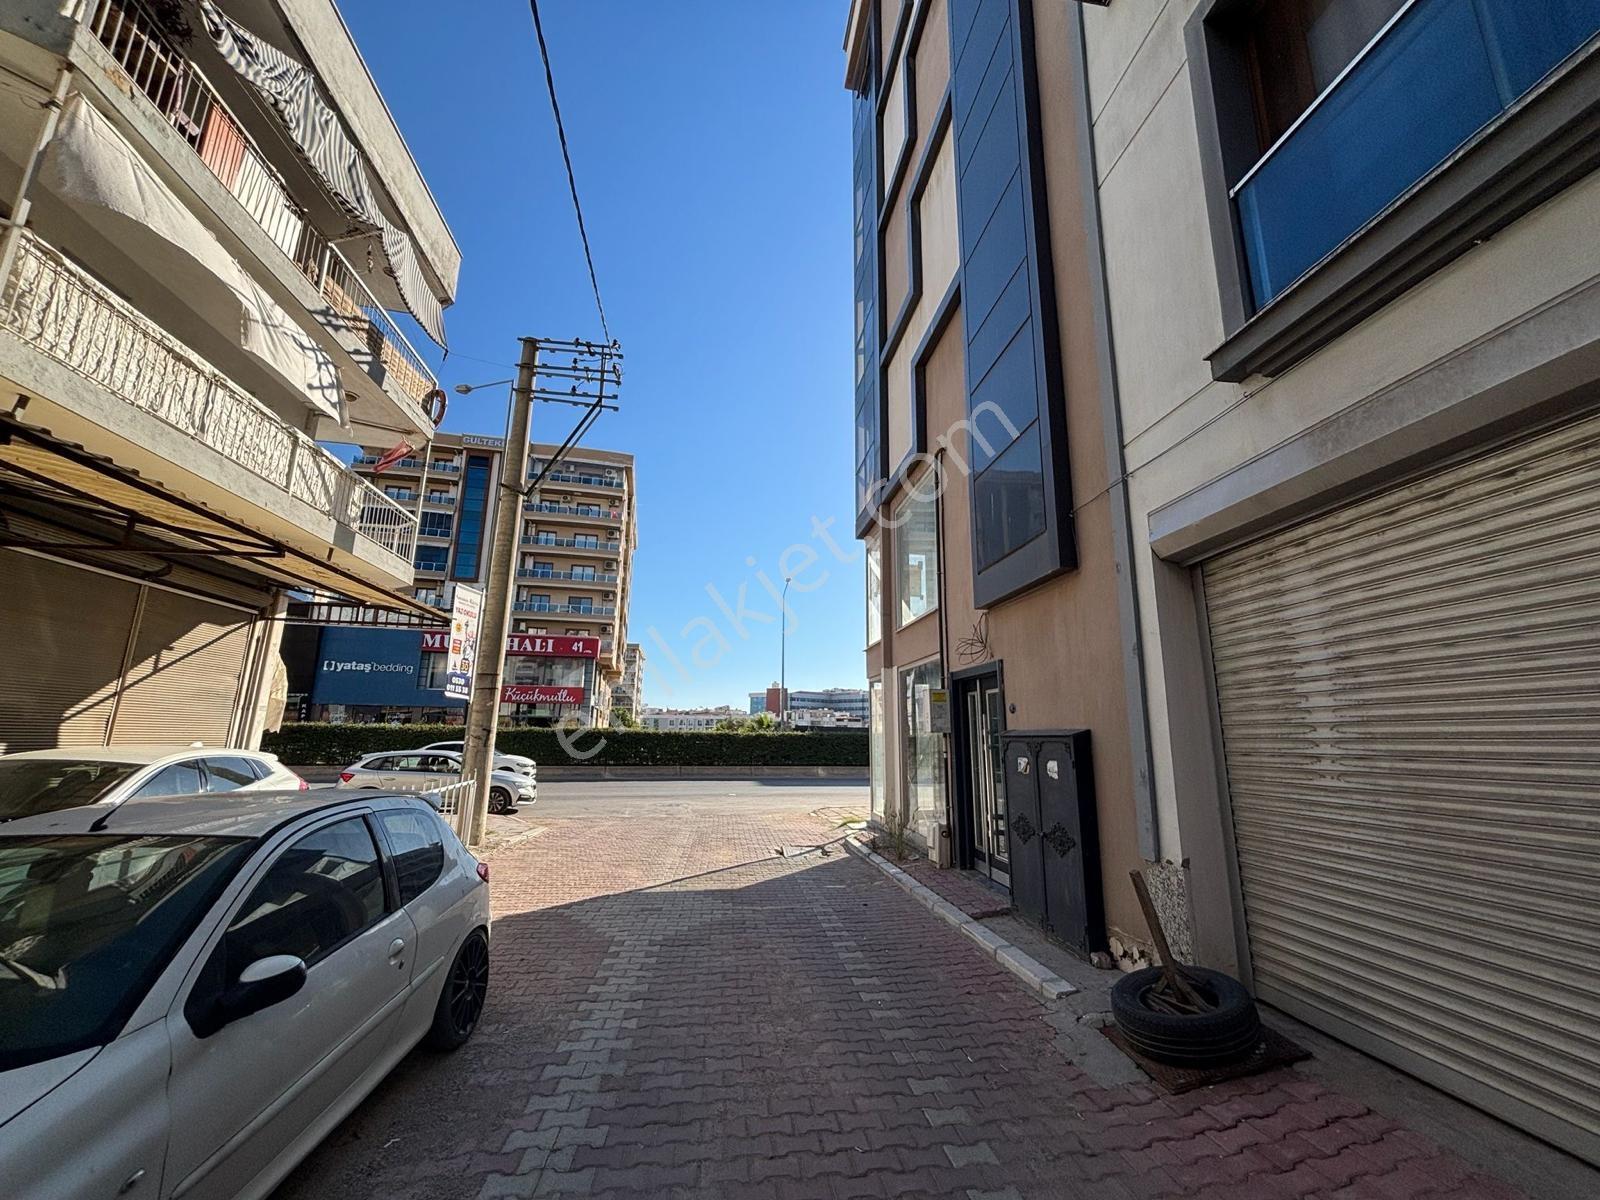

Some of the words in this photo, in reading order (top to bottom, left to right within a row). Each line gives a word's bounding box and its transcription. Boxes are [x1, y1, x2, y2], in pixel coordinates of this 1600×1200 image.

[572, 641, 584, 653] 41
[373, 661, 413, 674] bedding
[505, 687, 576, 702] Küçükmutlu
